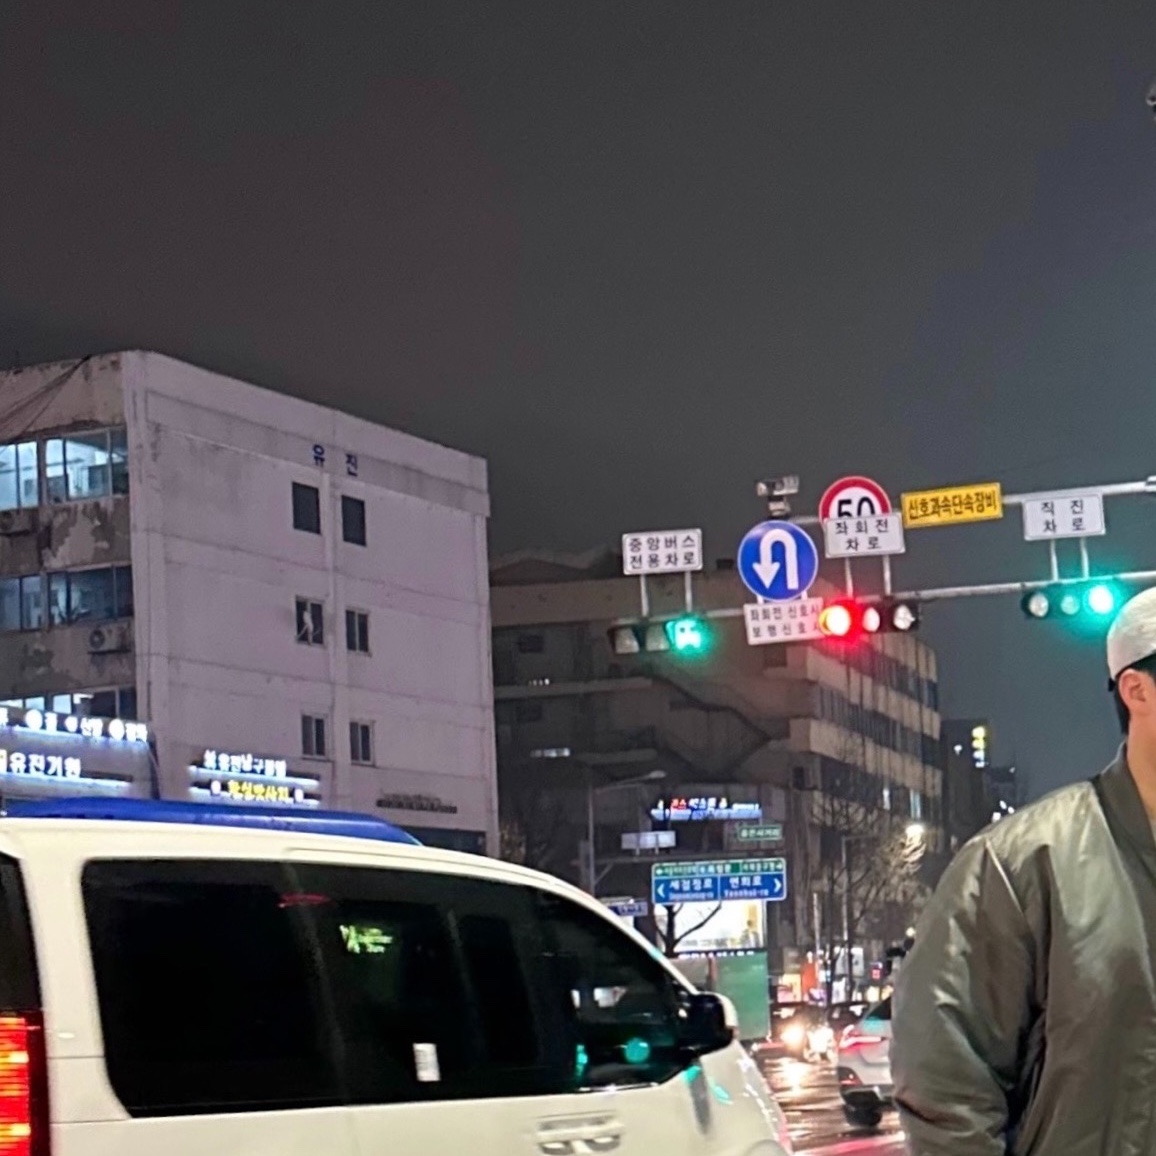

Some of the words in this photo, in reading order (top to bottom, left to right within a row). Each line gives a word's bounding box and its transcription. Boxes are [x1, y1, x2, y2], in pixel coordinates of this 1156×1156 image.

[313, 444, 358, 477] 유진
[1041, 500, 1084, 516] 직진
[835, 519, 889, 535] 좌회전
[1043, 517, 1086, 533] 차로
[629, 535, 696, 553] 중앙버스
[846, 536, 882, 551] 차로
[630, 552, 695, 570] 전용차로
[729, 875, 762, 889] 연희로
